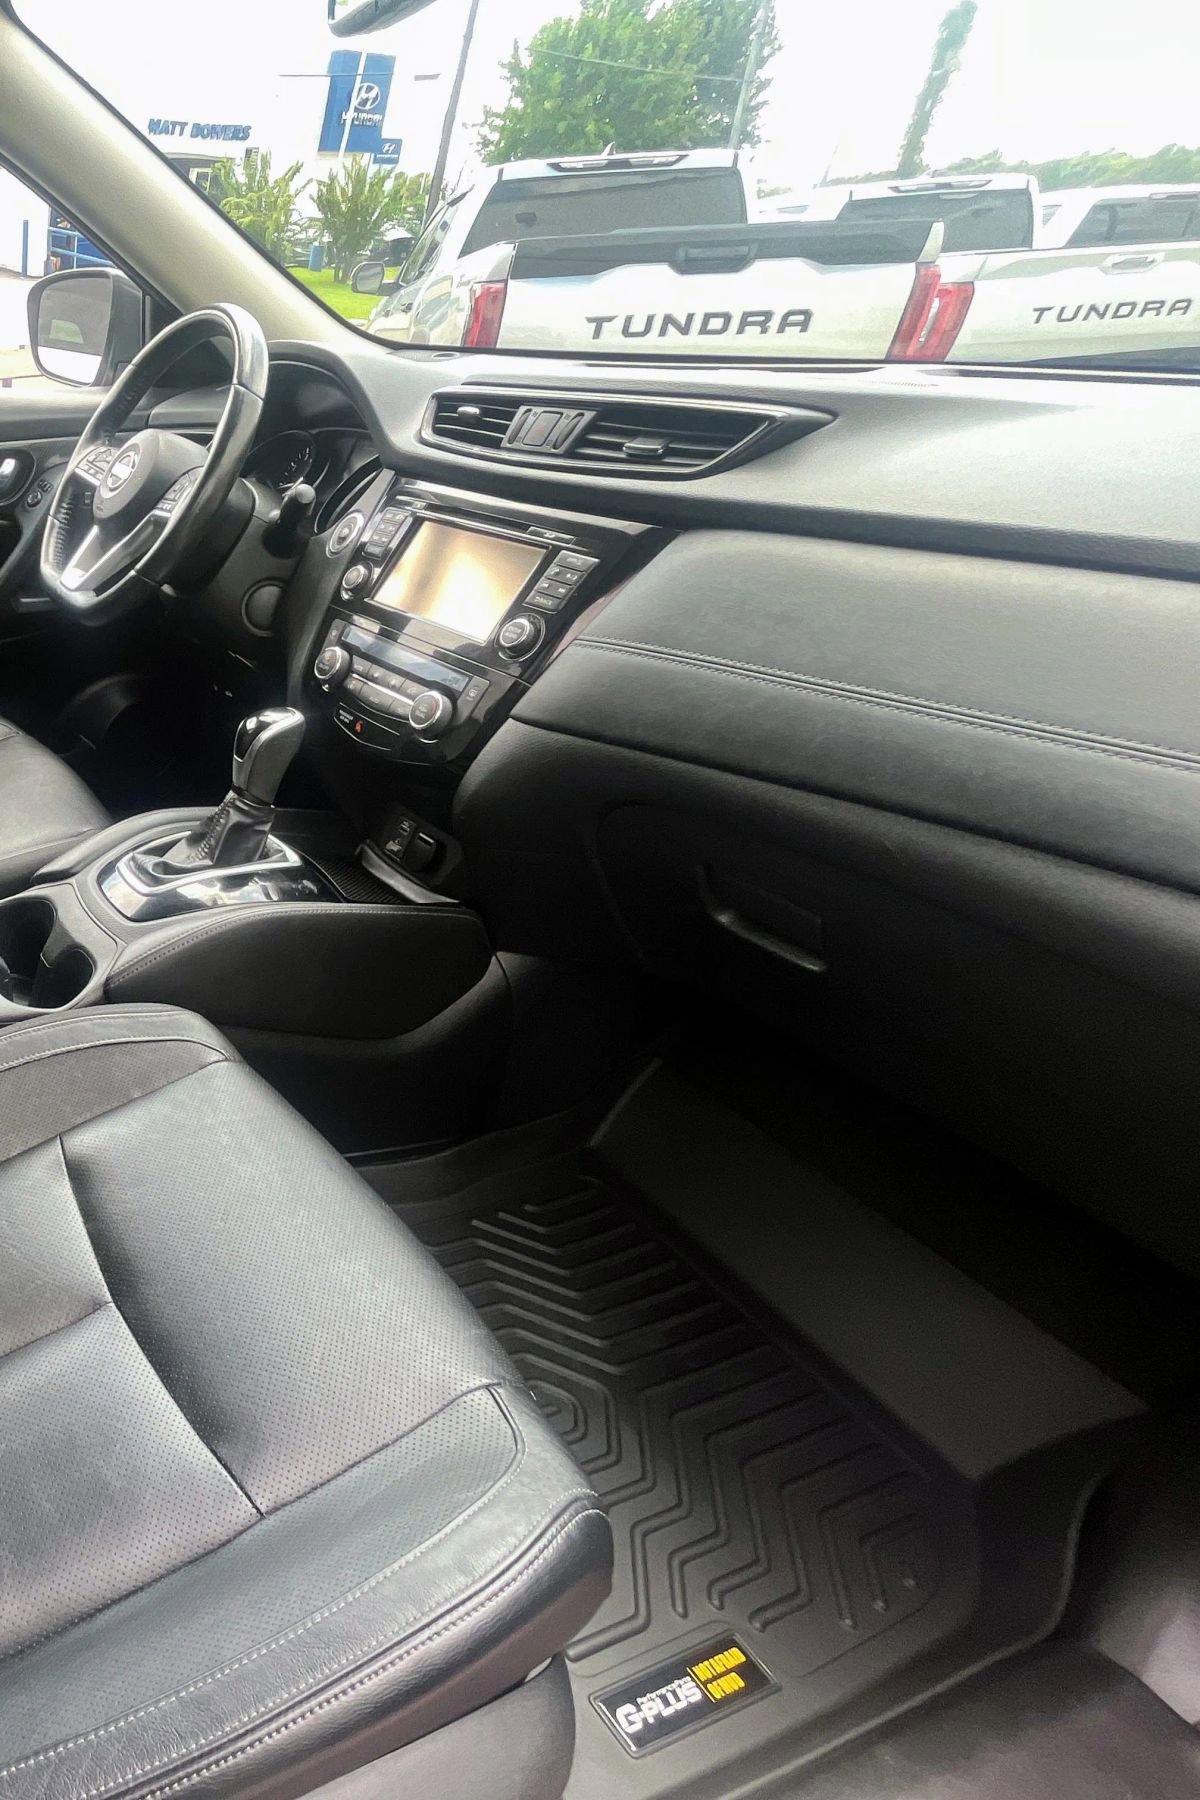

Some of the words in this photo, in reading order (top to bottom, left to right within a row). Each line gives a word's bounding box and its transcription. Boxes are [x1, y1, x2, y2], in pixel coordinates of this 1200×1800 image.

[148, 119, 188, 136] MATT
[190, 123, 252, 141] BOWERS
[584, 308, 813, 340] TUNDRA
[1032, 298, 1193, 324] TUNDRA
[615, 1680, 702, 1733] G-PLUS
